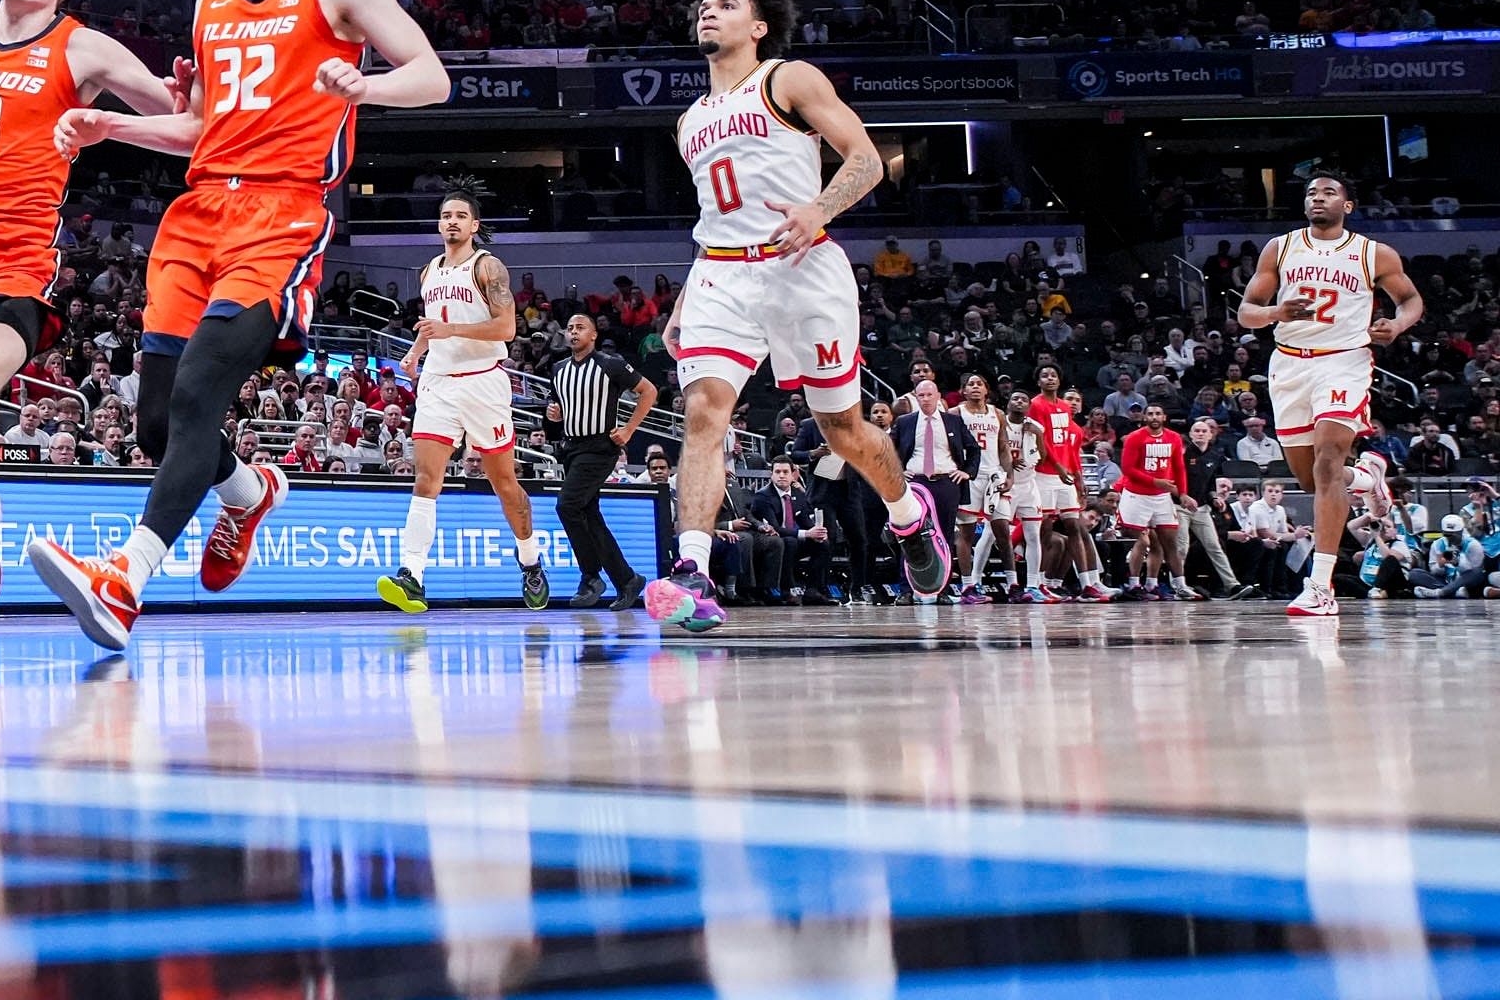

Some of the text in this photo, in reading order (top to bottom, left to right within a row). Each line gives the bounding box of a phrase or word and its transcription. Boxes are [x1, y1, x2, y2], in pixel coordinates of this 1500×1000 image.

[204, 14, 298, 42] ILLINOIS
[214, 44, 276, 114] 32
[670, 72, 709, 86] FAN
[1115, 67, 1243, 84] Sports Tech HQ
[1373, 60, 1466, 79] DONUTS
[853, 76, 1015, 93] Fanatics Sportsbook
[709, 156, 742, 215] 0
[1075, 235, 1083, 254] 8
[1186, 238, 1194, 252] 9
[1286, 266, 1360, 293] MARYLAND
[423, 285, 473, 306] MARYLAND
[1298, 285, 1339, 325] 22
[814, 340, 841, 367] M
[1330, 389, 1348, 404] M
[492, 423, 507, 441] M
[977, 433, 987, 450] 5
[4, 444, 30, 461] POSS.
[1144, 458, 1157, 471] US
[246, 525, 330, 567] AMES
